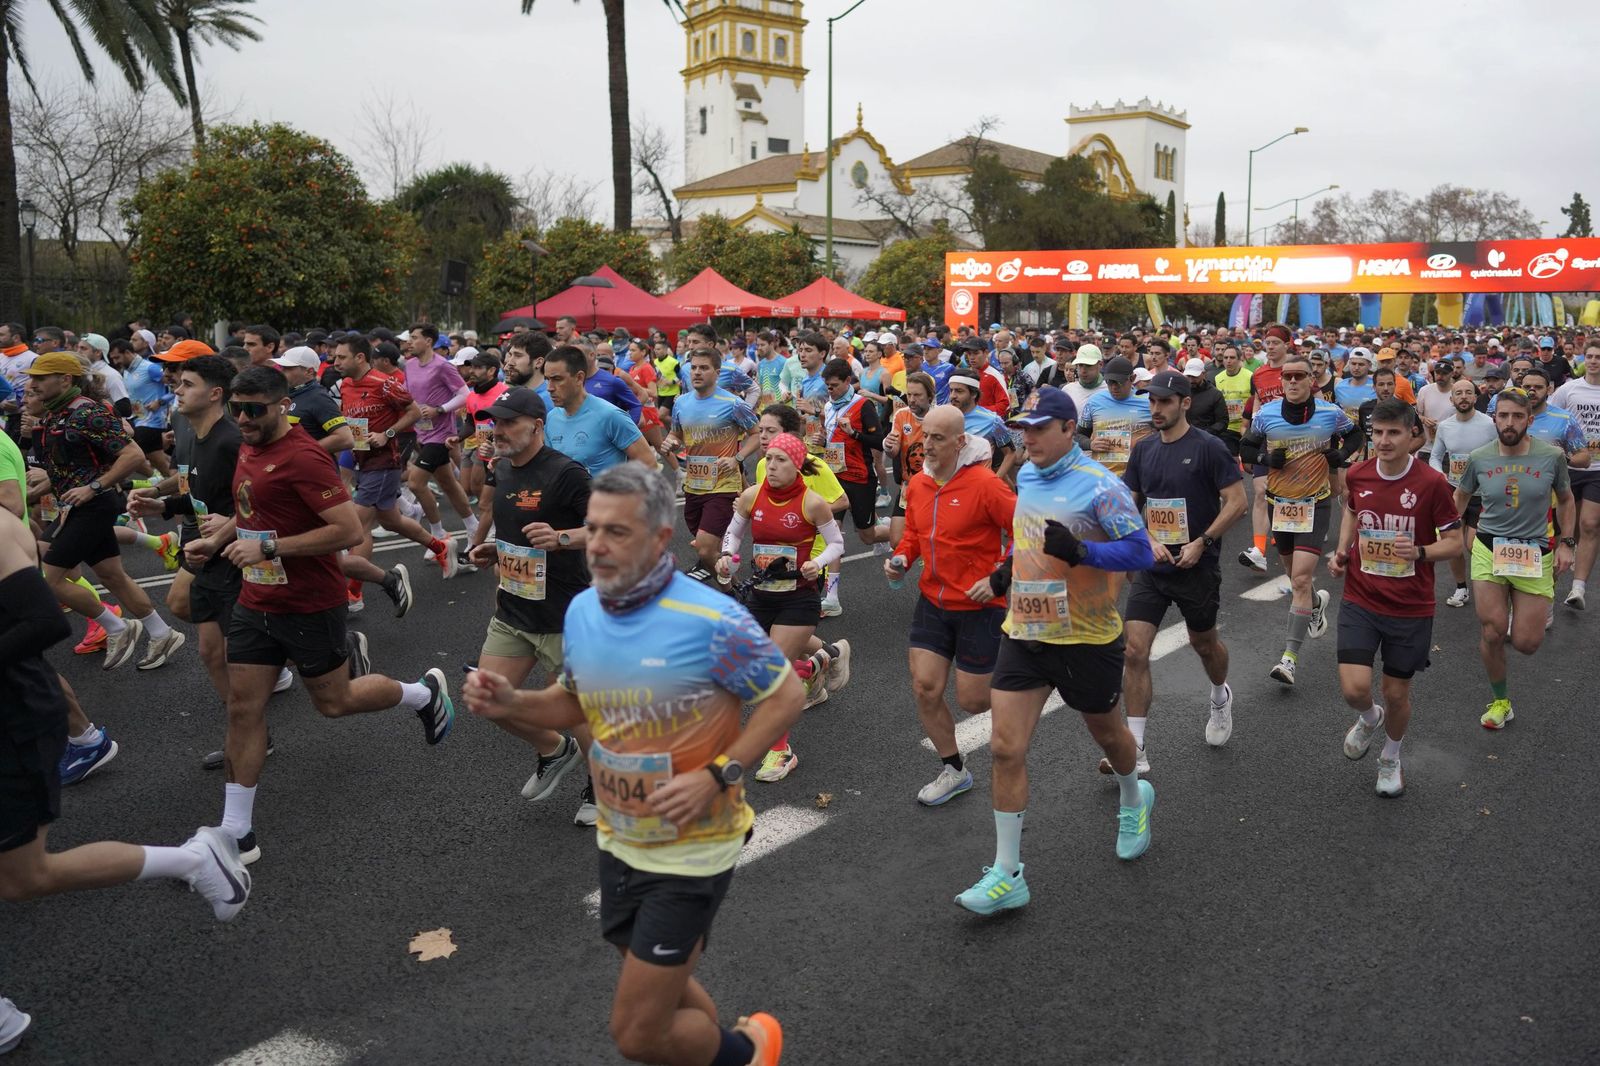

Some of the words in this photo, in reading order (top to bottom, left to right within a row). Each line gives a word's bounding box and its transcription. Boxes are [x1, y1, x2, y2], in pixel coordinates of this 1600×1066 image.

[1098, 264, 1140, 279] HOKA
[1357, 259, 1412, 276] HOKA
[690, 464, 709, 475] 5370
[1151, 510, 1174, 524] 8020
[1280, 505, 1304, 517] 4231
[1500, 546, 1530, 561] 4991
[502, 555, 529, 576] 4741
[1017, 597, 1050, 614] 4391
